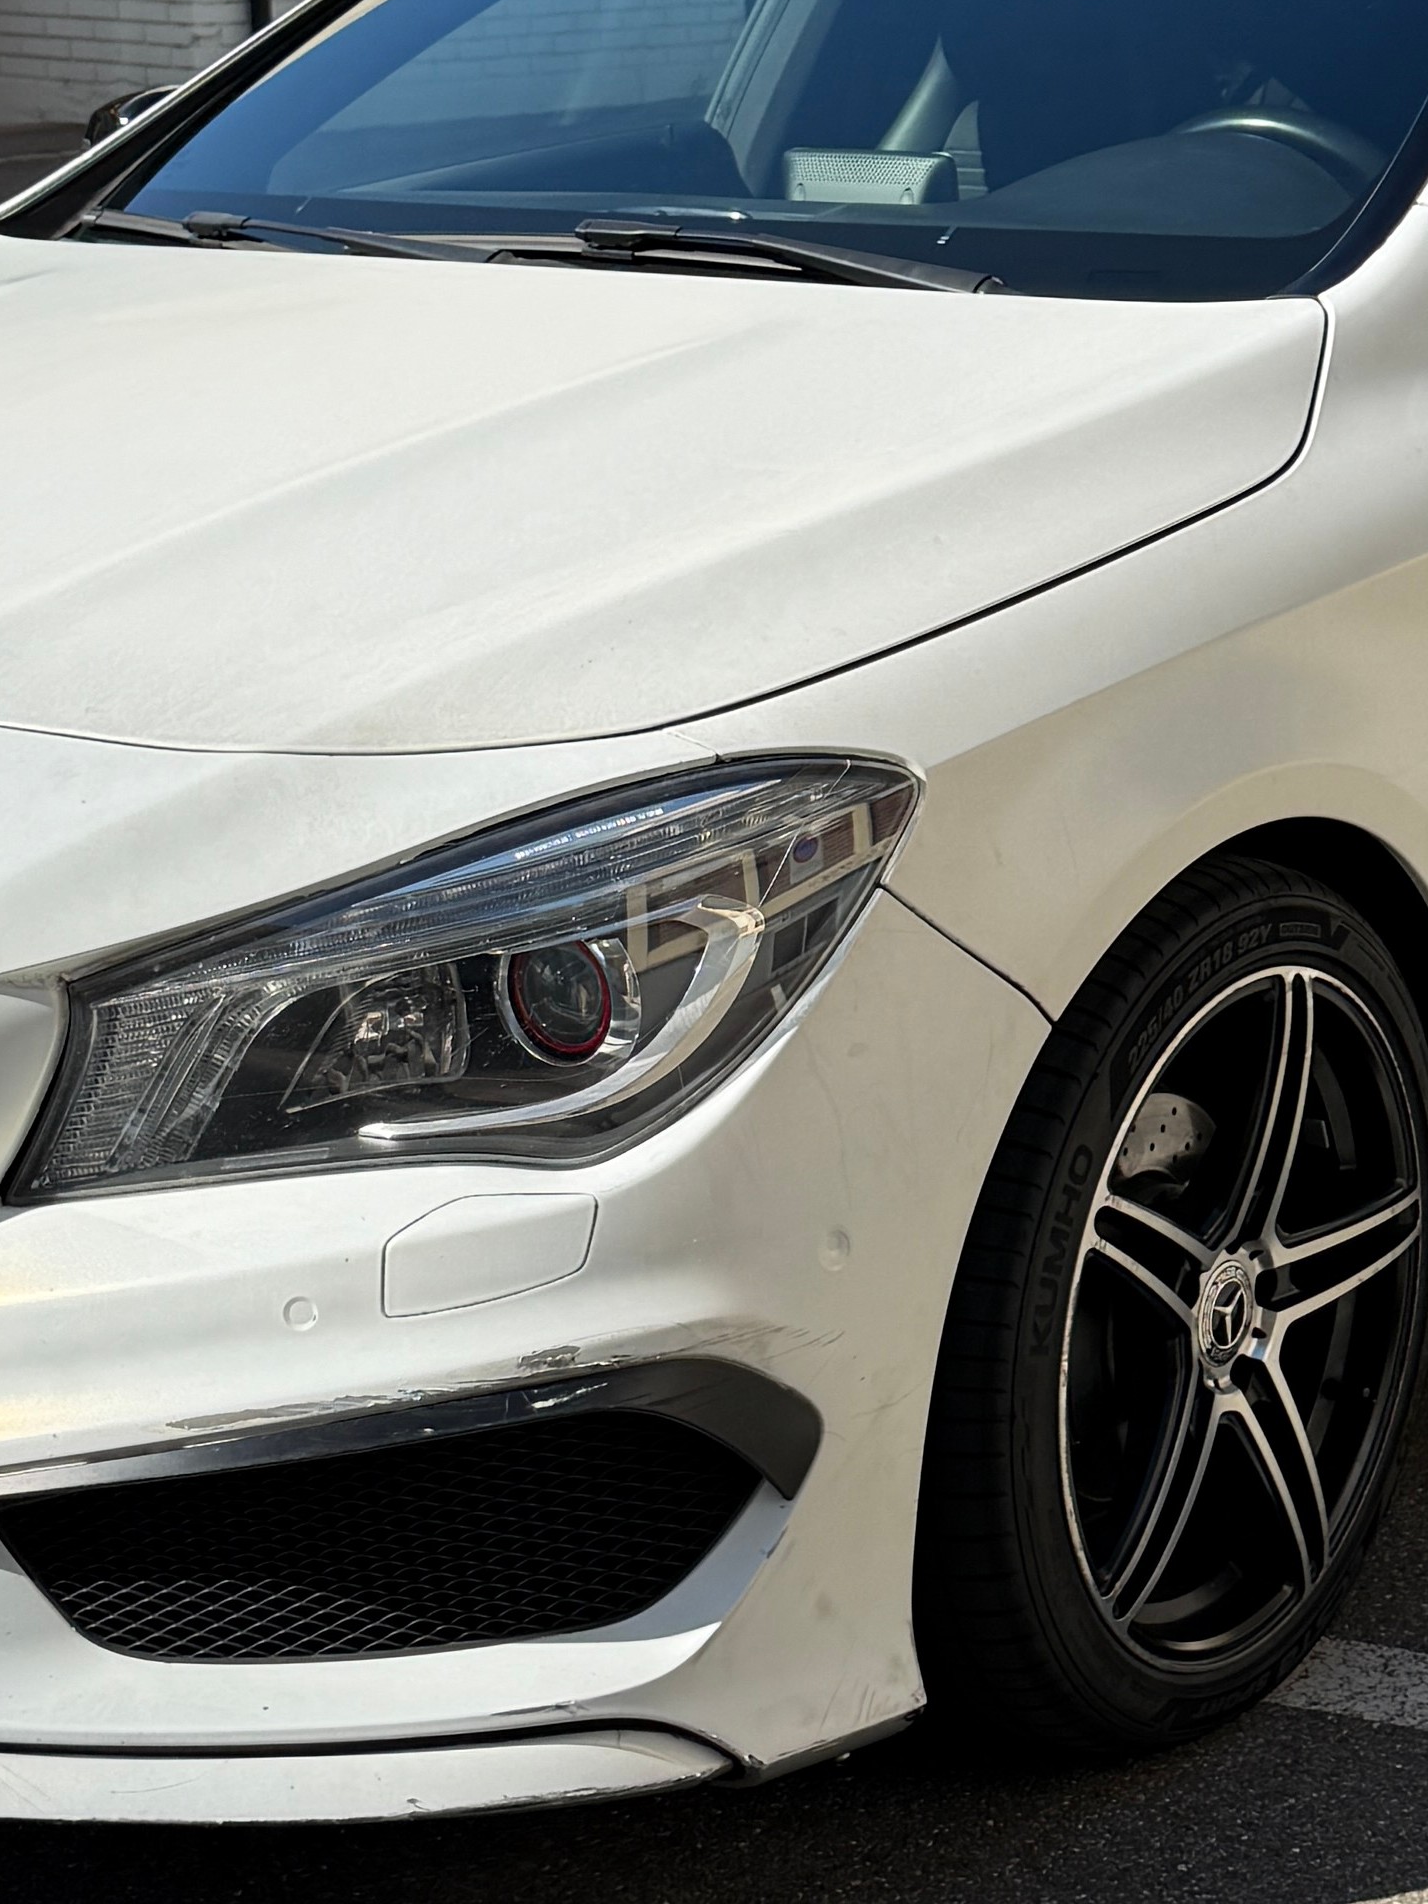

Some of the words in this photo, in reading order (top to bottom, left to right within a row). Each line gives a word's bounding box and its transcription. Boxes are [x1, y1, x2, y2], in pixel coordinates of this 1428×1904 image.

[1128, 984, 1184, 1074] 225/40
[1187, 940, 1234, 994] ZR18
[1236, 922, 1274, 956] 92Y
[1028, 1143, 1093, 1357] KUMHO
